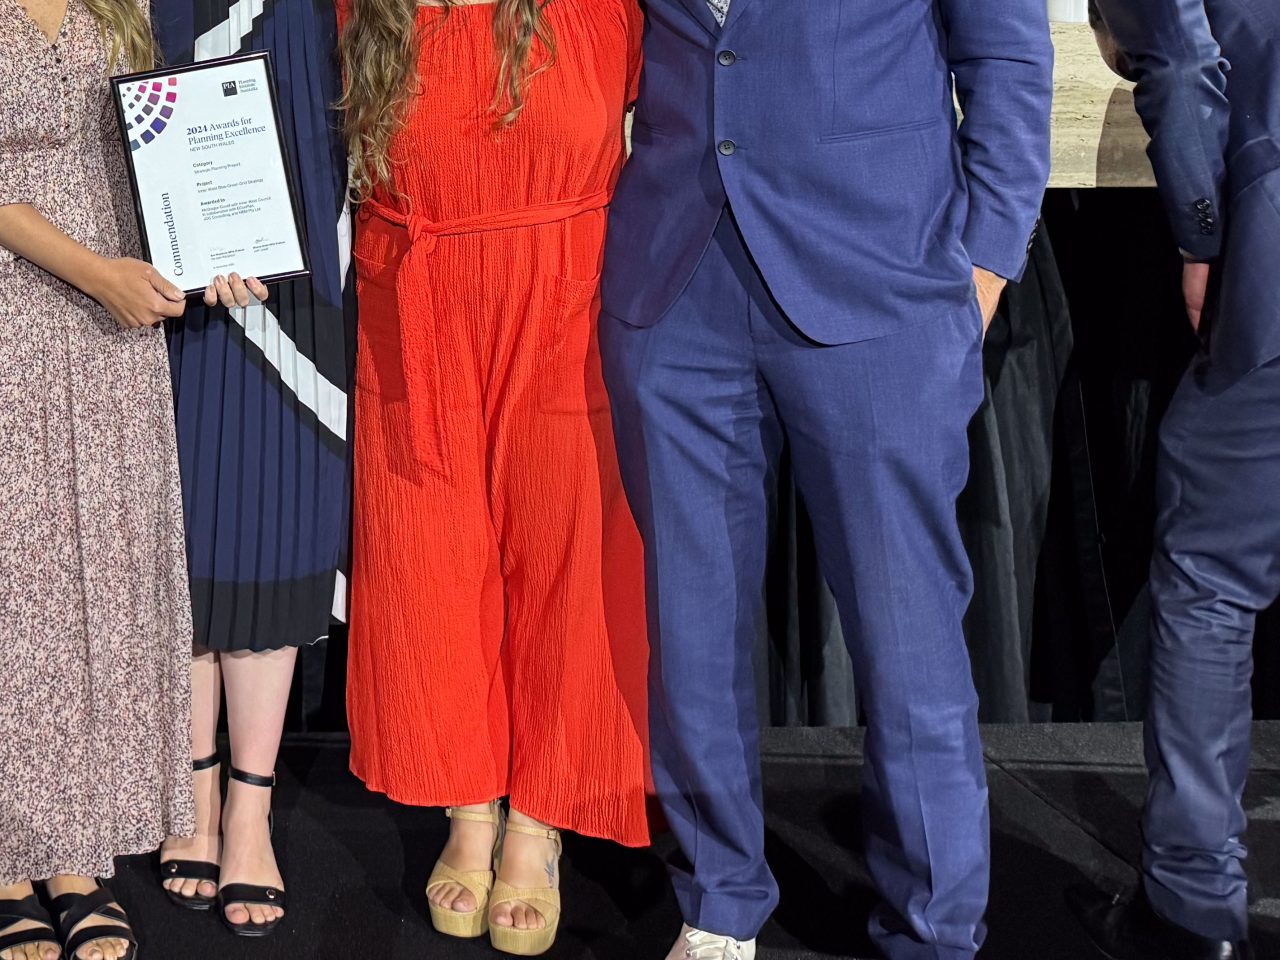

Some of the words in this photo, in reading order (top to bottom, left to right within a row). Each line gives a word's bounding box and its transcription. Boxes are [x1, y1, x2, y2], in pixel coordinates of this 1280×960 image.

[186, 125, 208, 135] 2024
[209, 119, 240, 132] Awards
[240, 117, 252, 126] for
[188, 134, 224, 146] Planning
[224, 126, 266, 139] Excellence
[161, 192, 184, 276] Commendation
